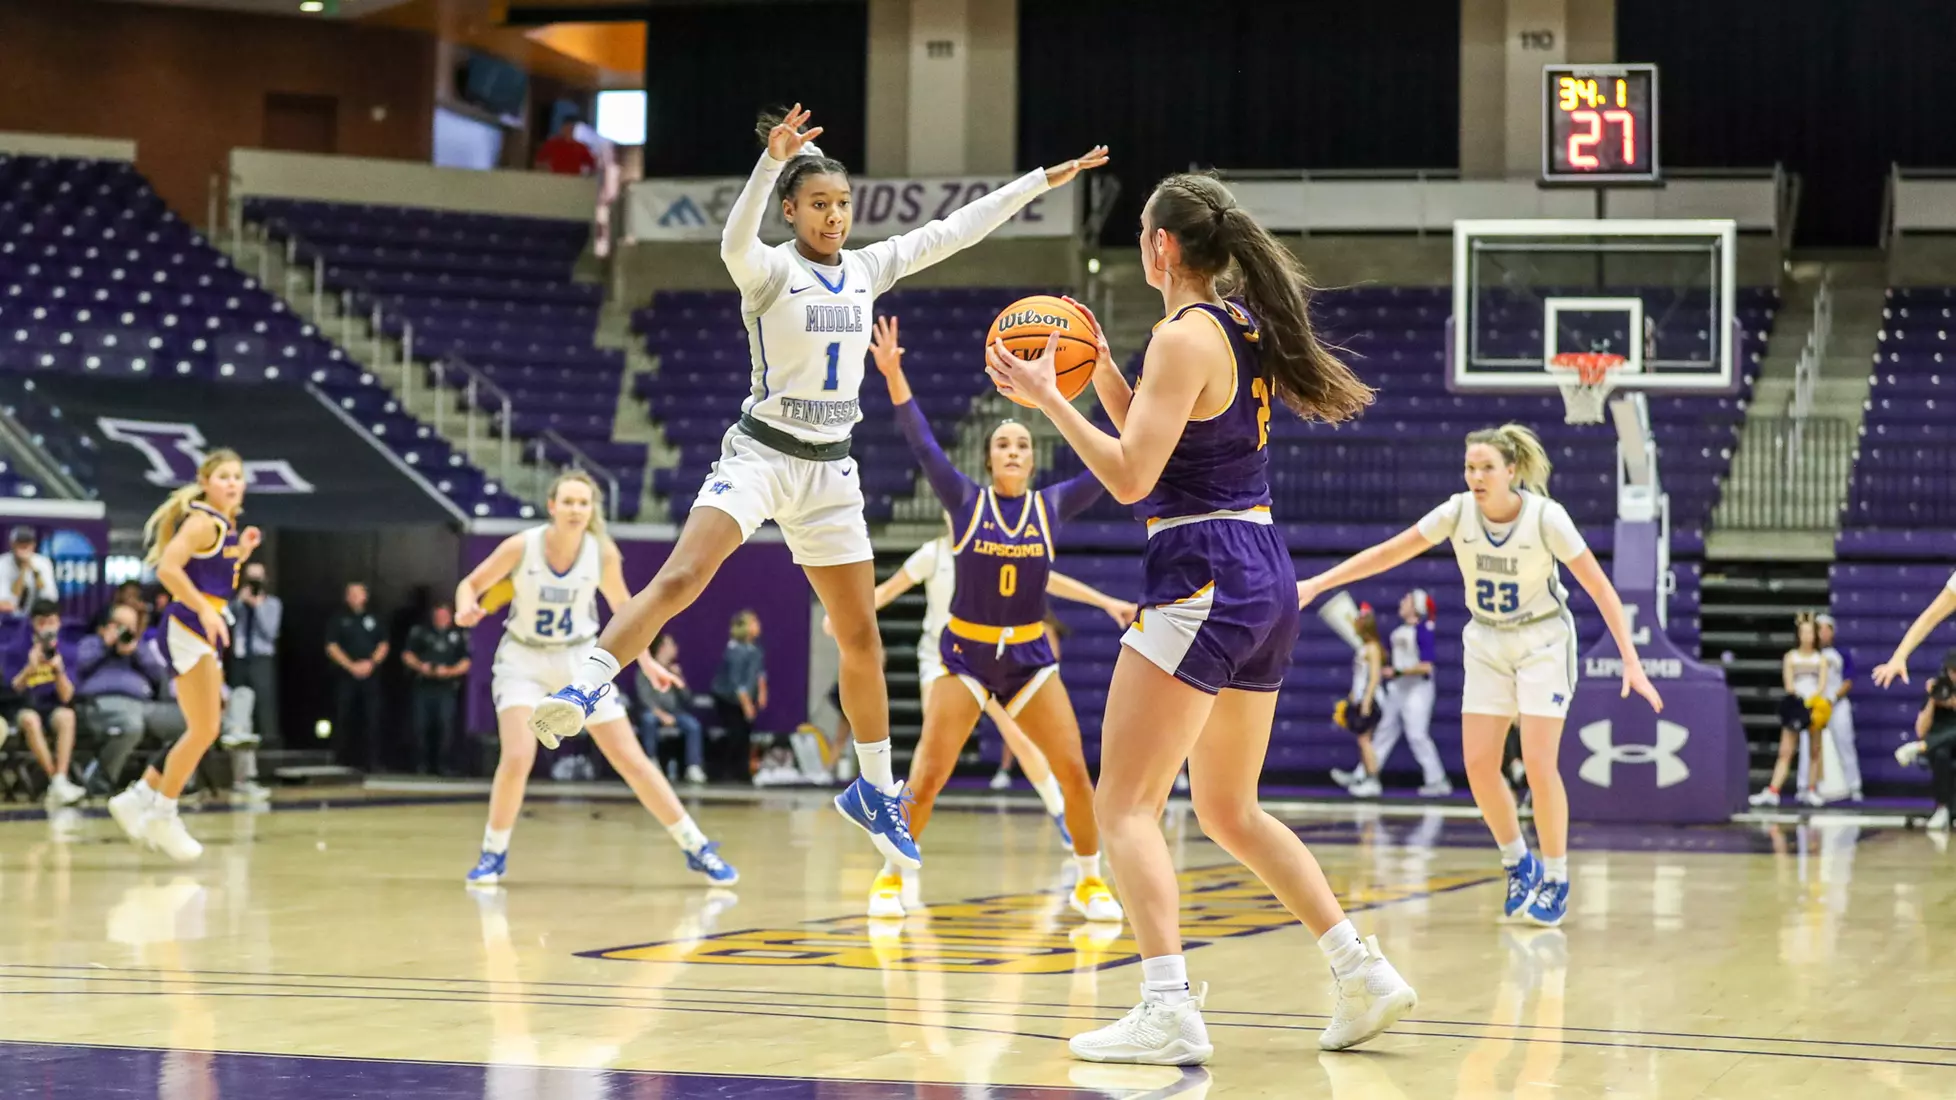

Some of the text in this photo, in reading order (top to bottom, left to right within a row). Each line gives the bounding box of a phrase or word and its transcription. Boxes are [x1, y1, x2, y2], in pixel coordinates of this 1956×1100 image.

[1560, 77, 1627, 111] 34.1
[1569, 110, 1634, 168] 27
[849, 183, 924, 224] IDS
[805, 304, 863, 332] MIDDLE
[998, 309, 1070, 332] Wilson
[821, 341, 840, 391] 1
[973, 539, 1045, 558] LIPSCOMB
[1000, 564, 1017, 597] 0
[1476, 579, 1519, 613] 23
[536, 607, 573, 637] 24
